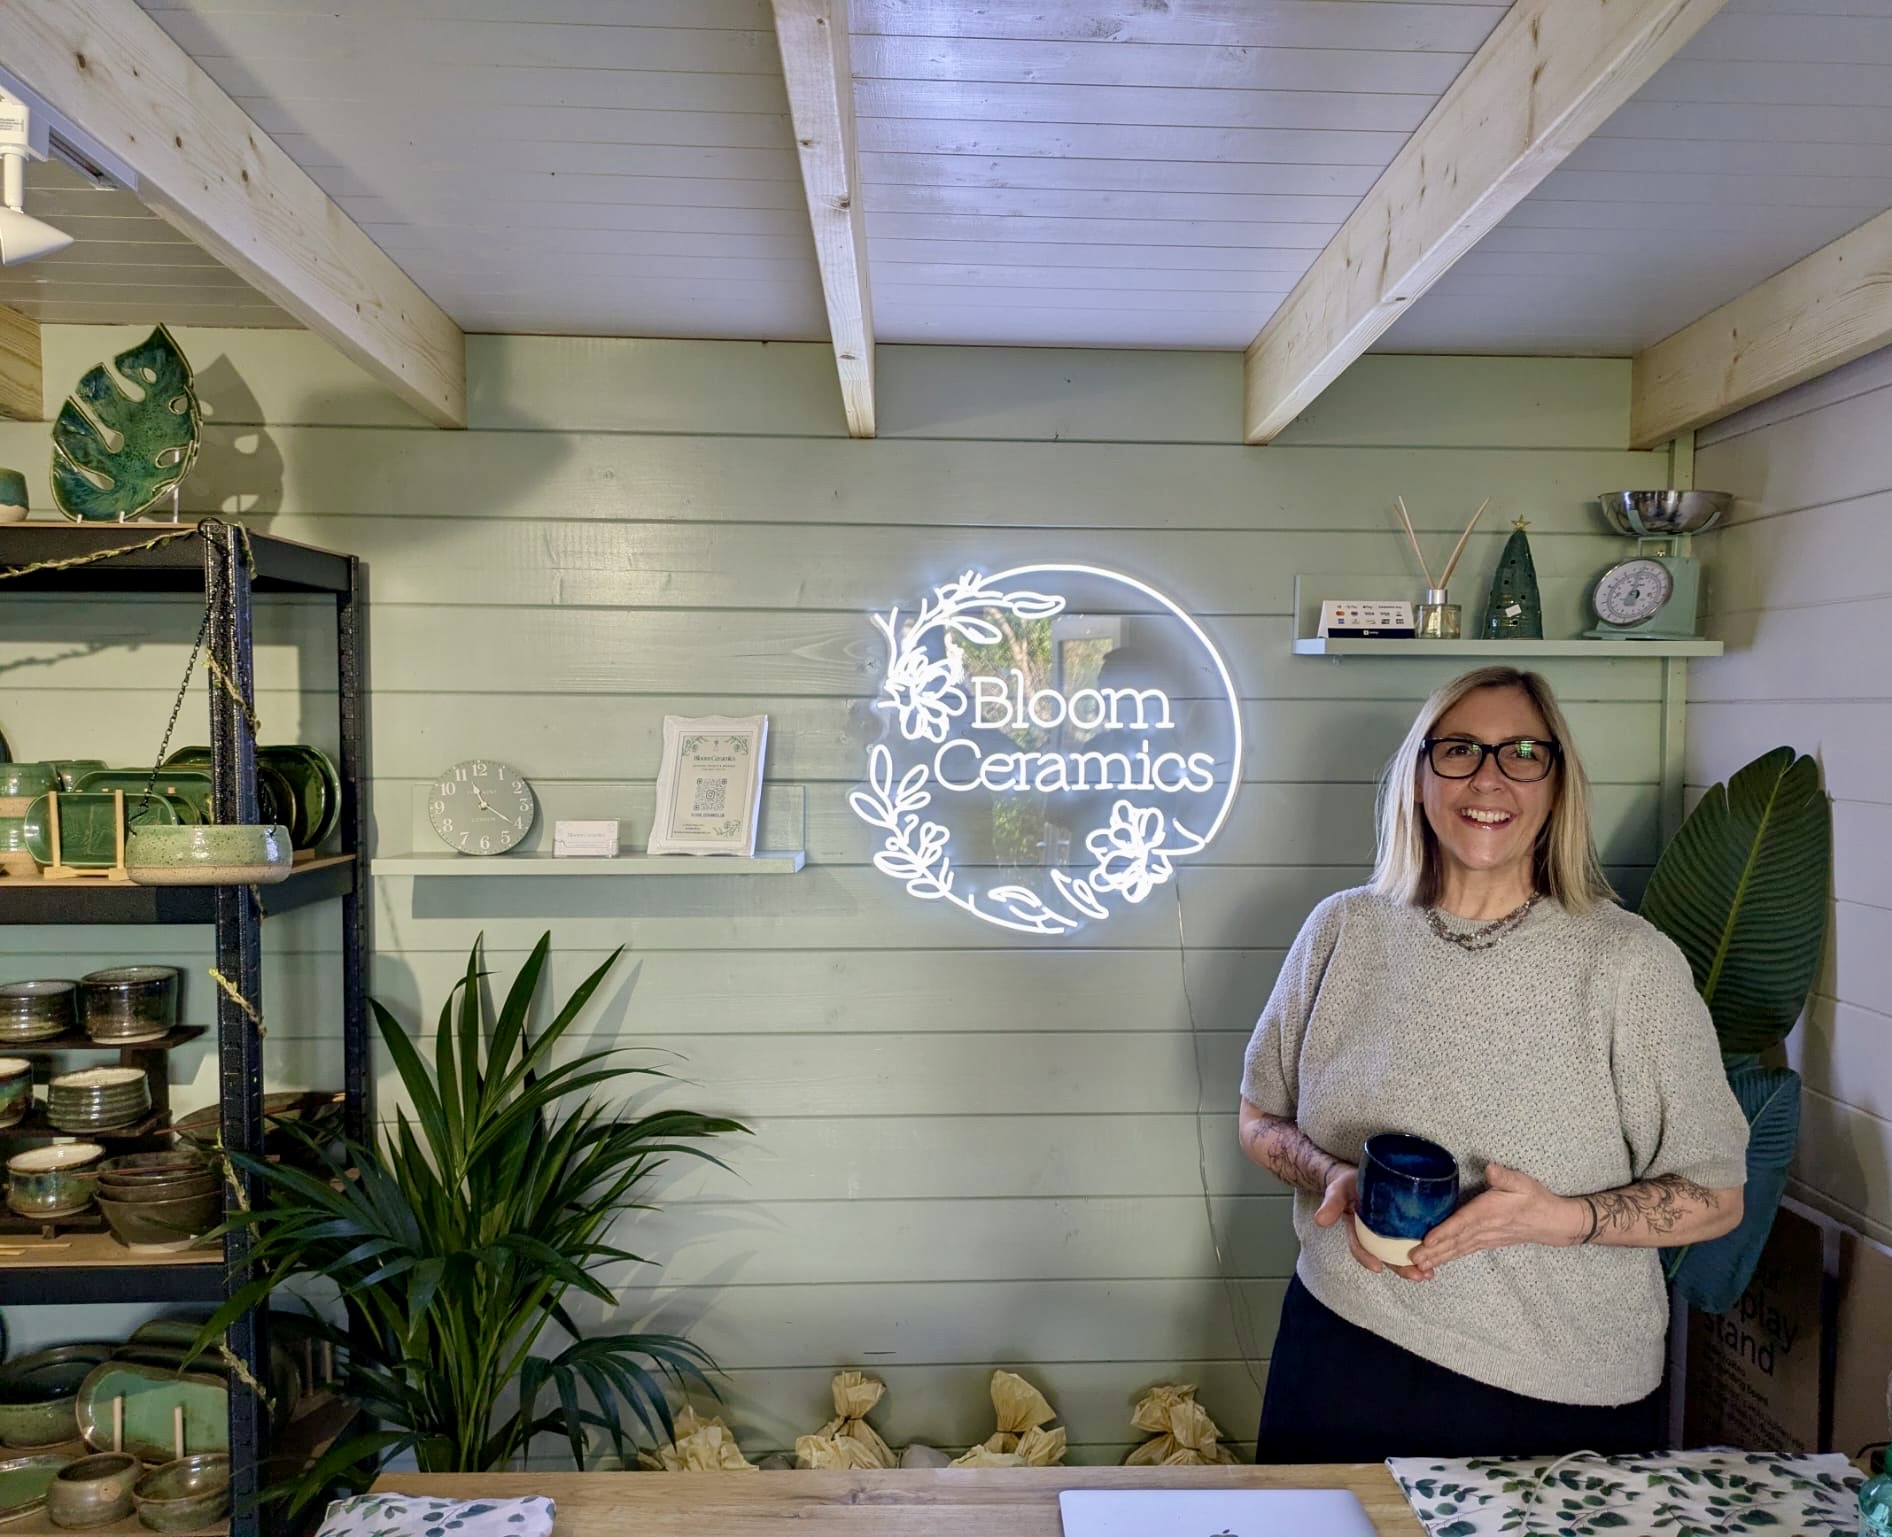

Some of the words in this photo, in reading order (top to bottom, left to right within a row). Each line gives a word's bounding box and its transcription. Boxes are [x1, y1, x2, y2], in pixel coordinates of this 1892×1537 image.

[970, 668, 1175, 729] Bloom
[472, 763, 488, 777] 12
[934, 739, 1215, 793] Ceramics
[455, 767, 467, 781] 11
[498, 767, 504, 781] 1
[440, 782, 456, 796] 10
[511, 781, 522, 794] 2
[434, 801, 445, 814] 9
[519, 798, 530, 811] 3
[442, 818, 453, 832] 8
[513, 816, 523, 830] 4
[460, 831, 470, 845] 7
[480, 835, 490, 849] 6
[500, 830, 511, 844] 5
[1733, 1290, 1802, 1354] play
[1703, 1312, 1774, 1377] stand
